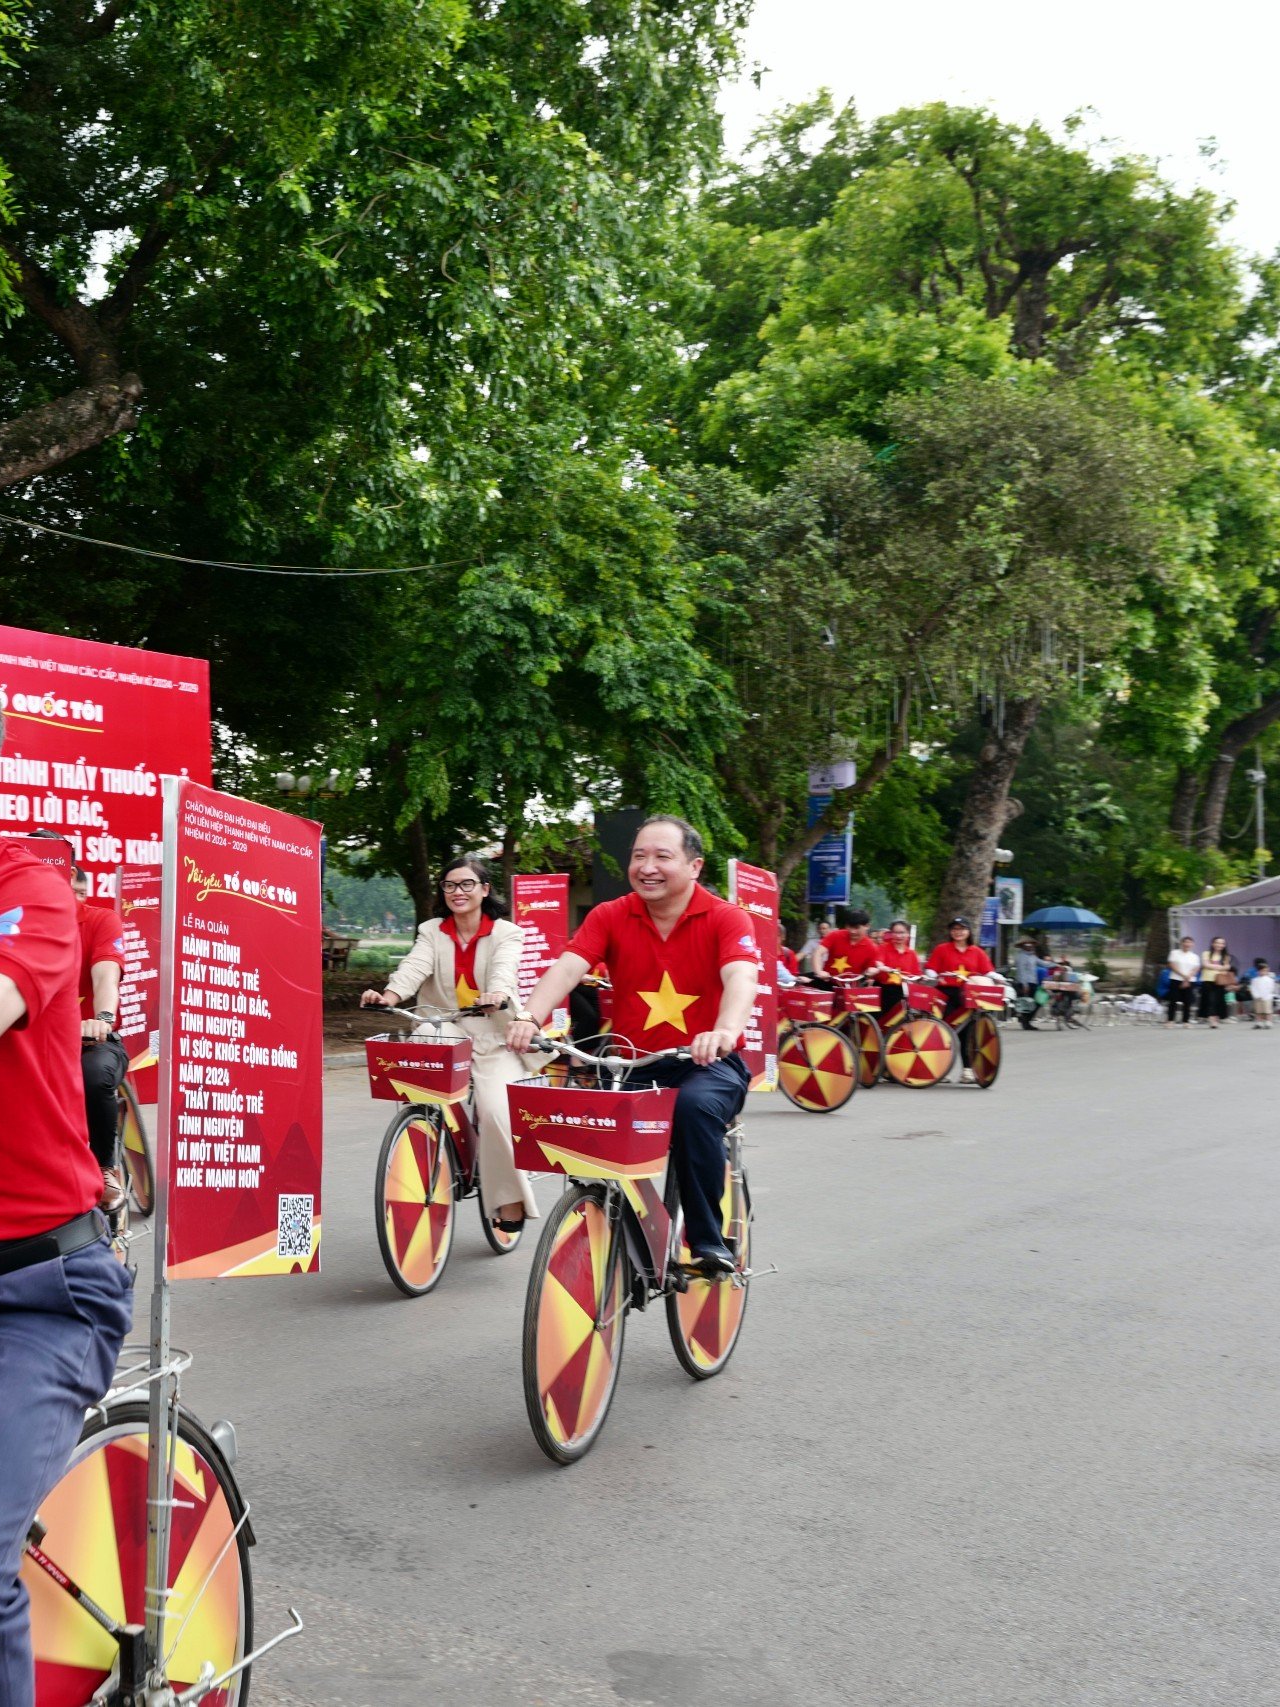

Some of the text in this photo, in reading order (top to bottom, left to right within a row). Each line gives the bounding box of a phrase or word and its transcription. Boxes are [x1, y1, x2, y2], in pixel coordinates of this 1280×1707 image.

[12, 692, 68, 717] QUỐC
[70, 700, 103, 723] TÔI
[100, 763, 156, 797] THUỐC
[33, 791, 63, 824] LỜI
[67, 795, 109, 831] BÁC,
[185, 800, 271, 834] CHÀO MỪNG ĐẠI HỘI ĐẠI BIỂU
[86, 831, 163, 865] SỨC KHỎ
[184, 813, 313, 859] HỘI LIÊN HIỆP THANH NIÊN VIỆT NAM CÁC CẤP,
[184, 827, 204, 841] NHIỆM
[212, 834, 227, 847] 2024
[233, 841, 247, 852] 2029
[224, 870, 240, 892] TỔ
[243, 879, 275, 900] QUỐC
[277, 887, 297, 906] TÔI
[195, 918, 206, 930] RA
[207, 920, 229, 935] QUÂN
[182, 933, 241, 964] HÀNH TRÌNH
[182, 958, 260, 992] THẦY THUỐC TRẺ
[181, 984, 271, 1020] LÀM THEO LỜI BÁC,
[180, 1009, 245, 1039] TÌNH NGUYỆN
[180, 1034, 297, 1069] VÌ SỨC KHỎE CỘNG ĐỒNG
[179, 1061, 230, 1086] NĂM 2024
[212, 1088, 244, 1113] THUỐC
[246, 1090, 264, 1114] TRẺ
[178, 1112, 244, 1141] TÌNH NGUYỆN
[566, 1114, 595, 1127] QUỐC
[597, 1117, 617, 1128] TÔI
[177, 1137, 261, 1166] VÌ MỘT VIỆT NAM
[176, 1162, 203, 1188] KHỎE
[205, 1168, 236, 1192] MẠNH
